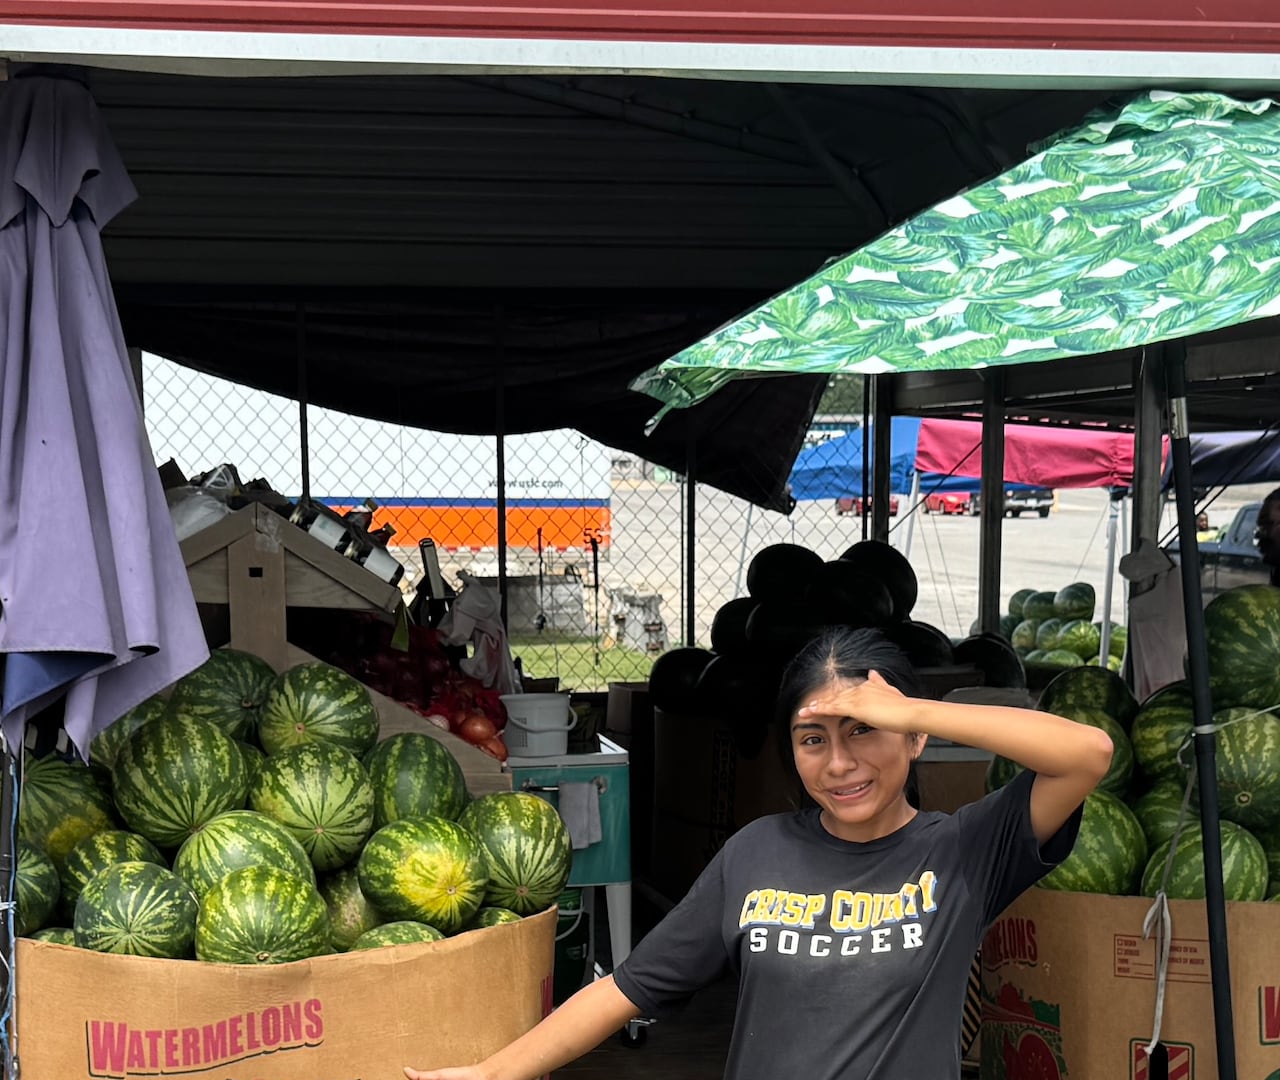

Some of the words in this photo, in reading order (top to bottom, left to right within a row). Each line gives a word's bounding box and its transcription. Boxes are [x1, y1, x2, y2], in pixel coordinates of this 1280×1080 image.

[739, 889, 826, 930] CRISP
[830, 871, 938, 932] COUNTY
[750, 923, 923, 957] SOCCER
[90, 998, 325, 1074] WATERMELONS
